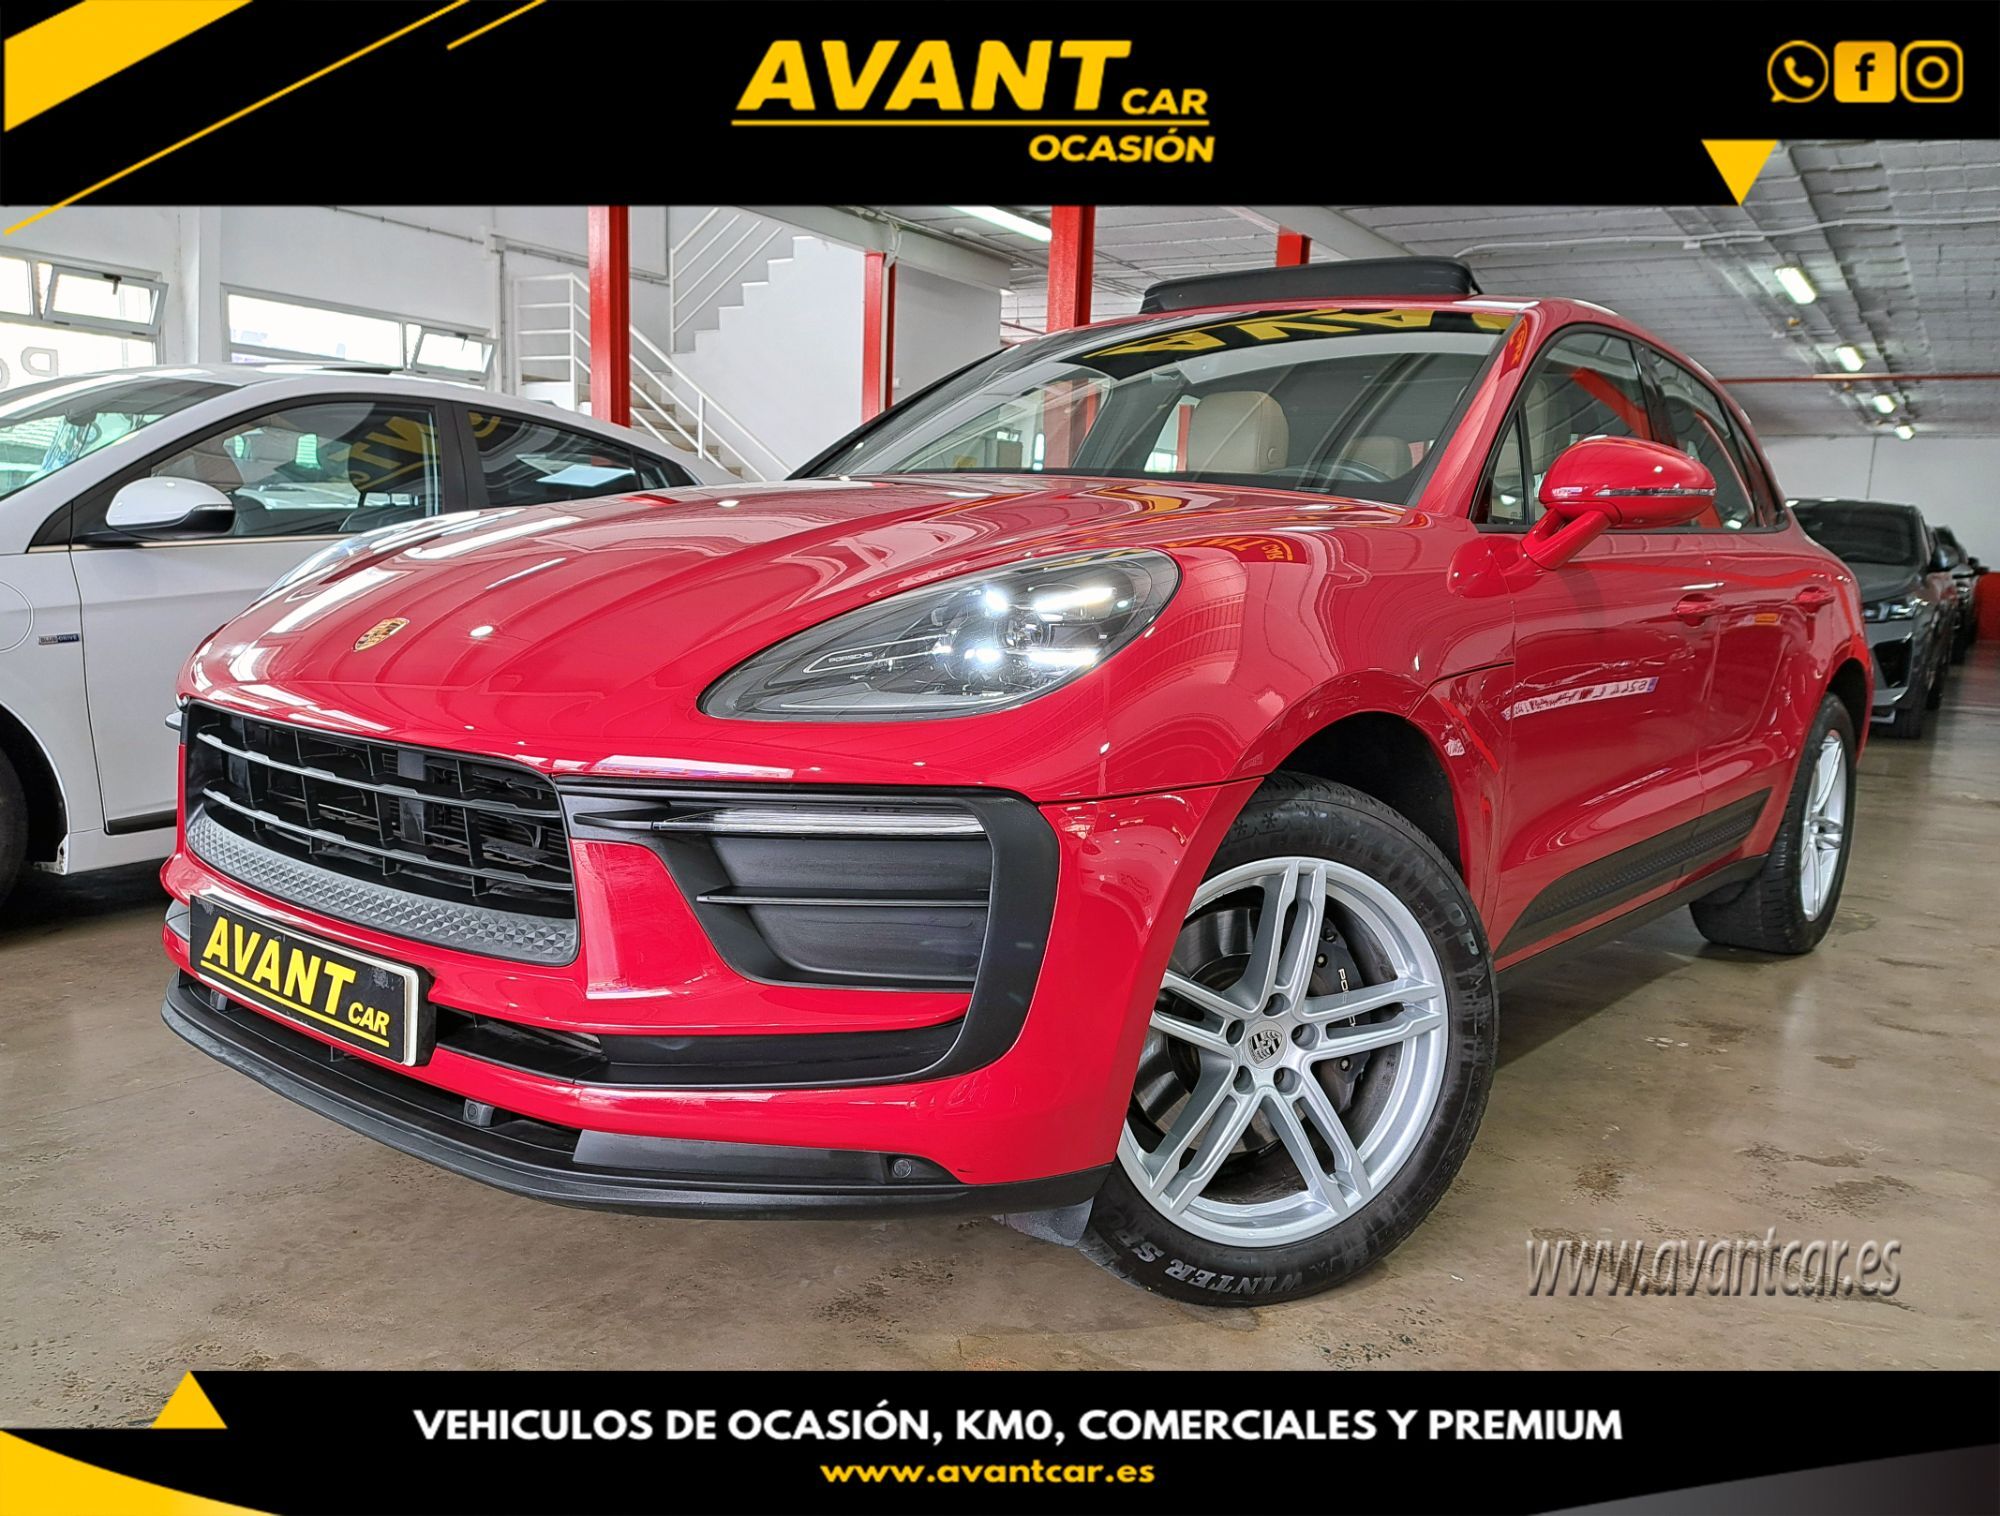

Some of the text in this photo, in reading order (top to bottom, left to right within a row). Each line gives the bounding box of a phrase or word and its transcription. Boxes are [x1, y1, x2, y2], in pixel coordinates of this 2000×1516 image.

[202, 916, 390, 1036] AVANT CAR
[1164, 1258, 1303, 1295] WINTER
